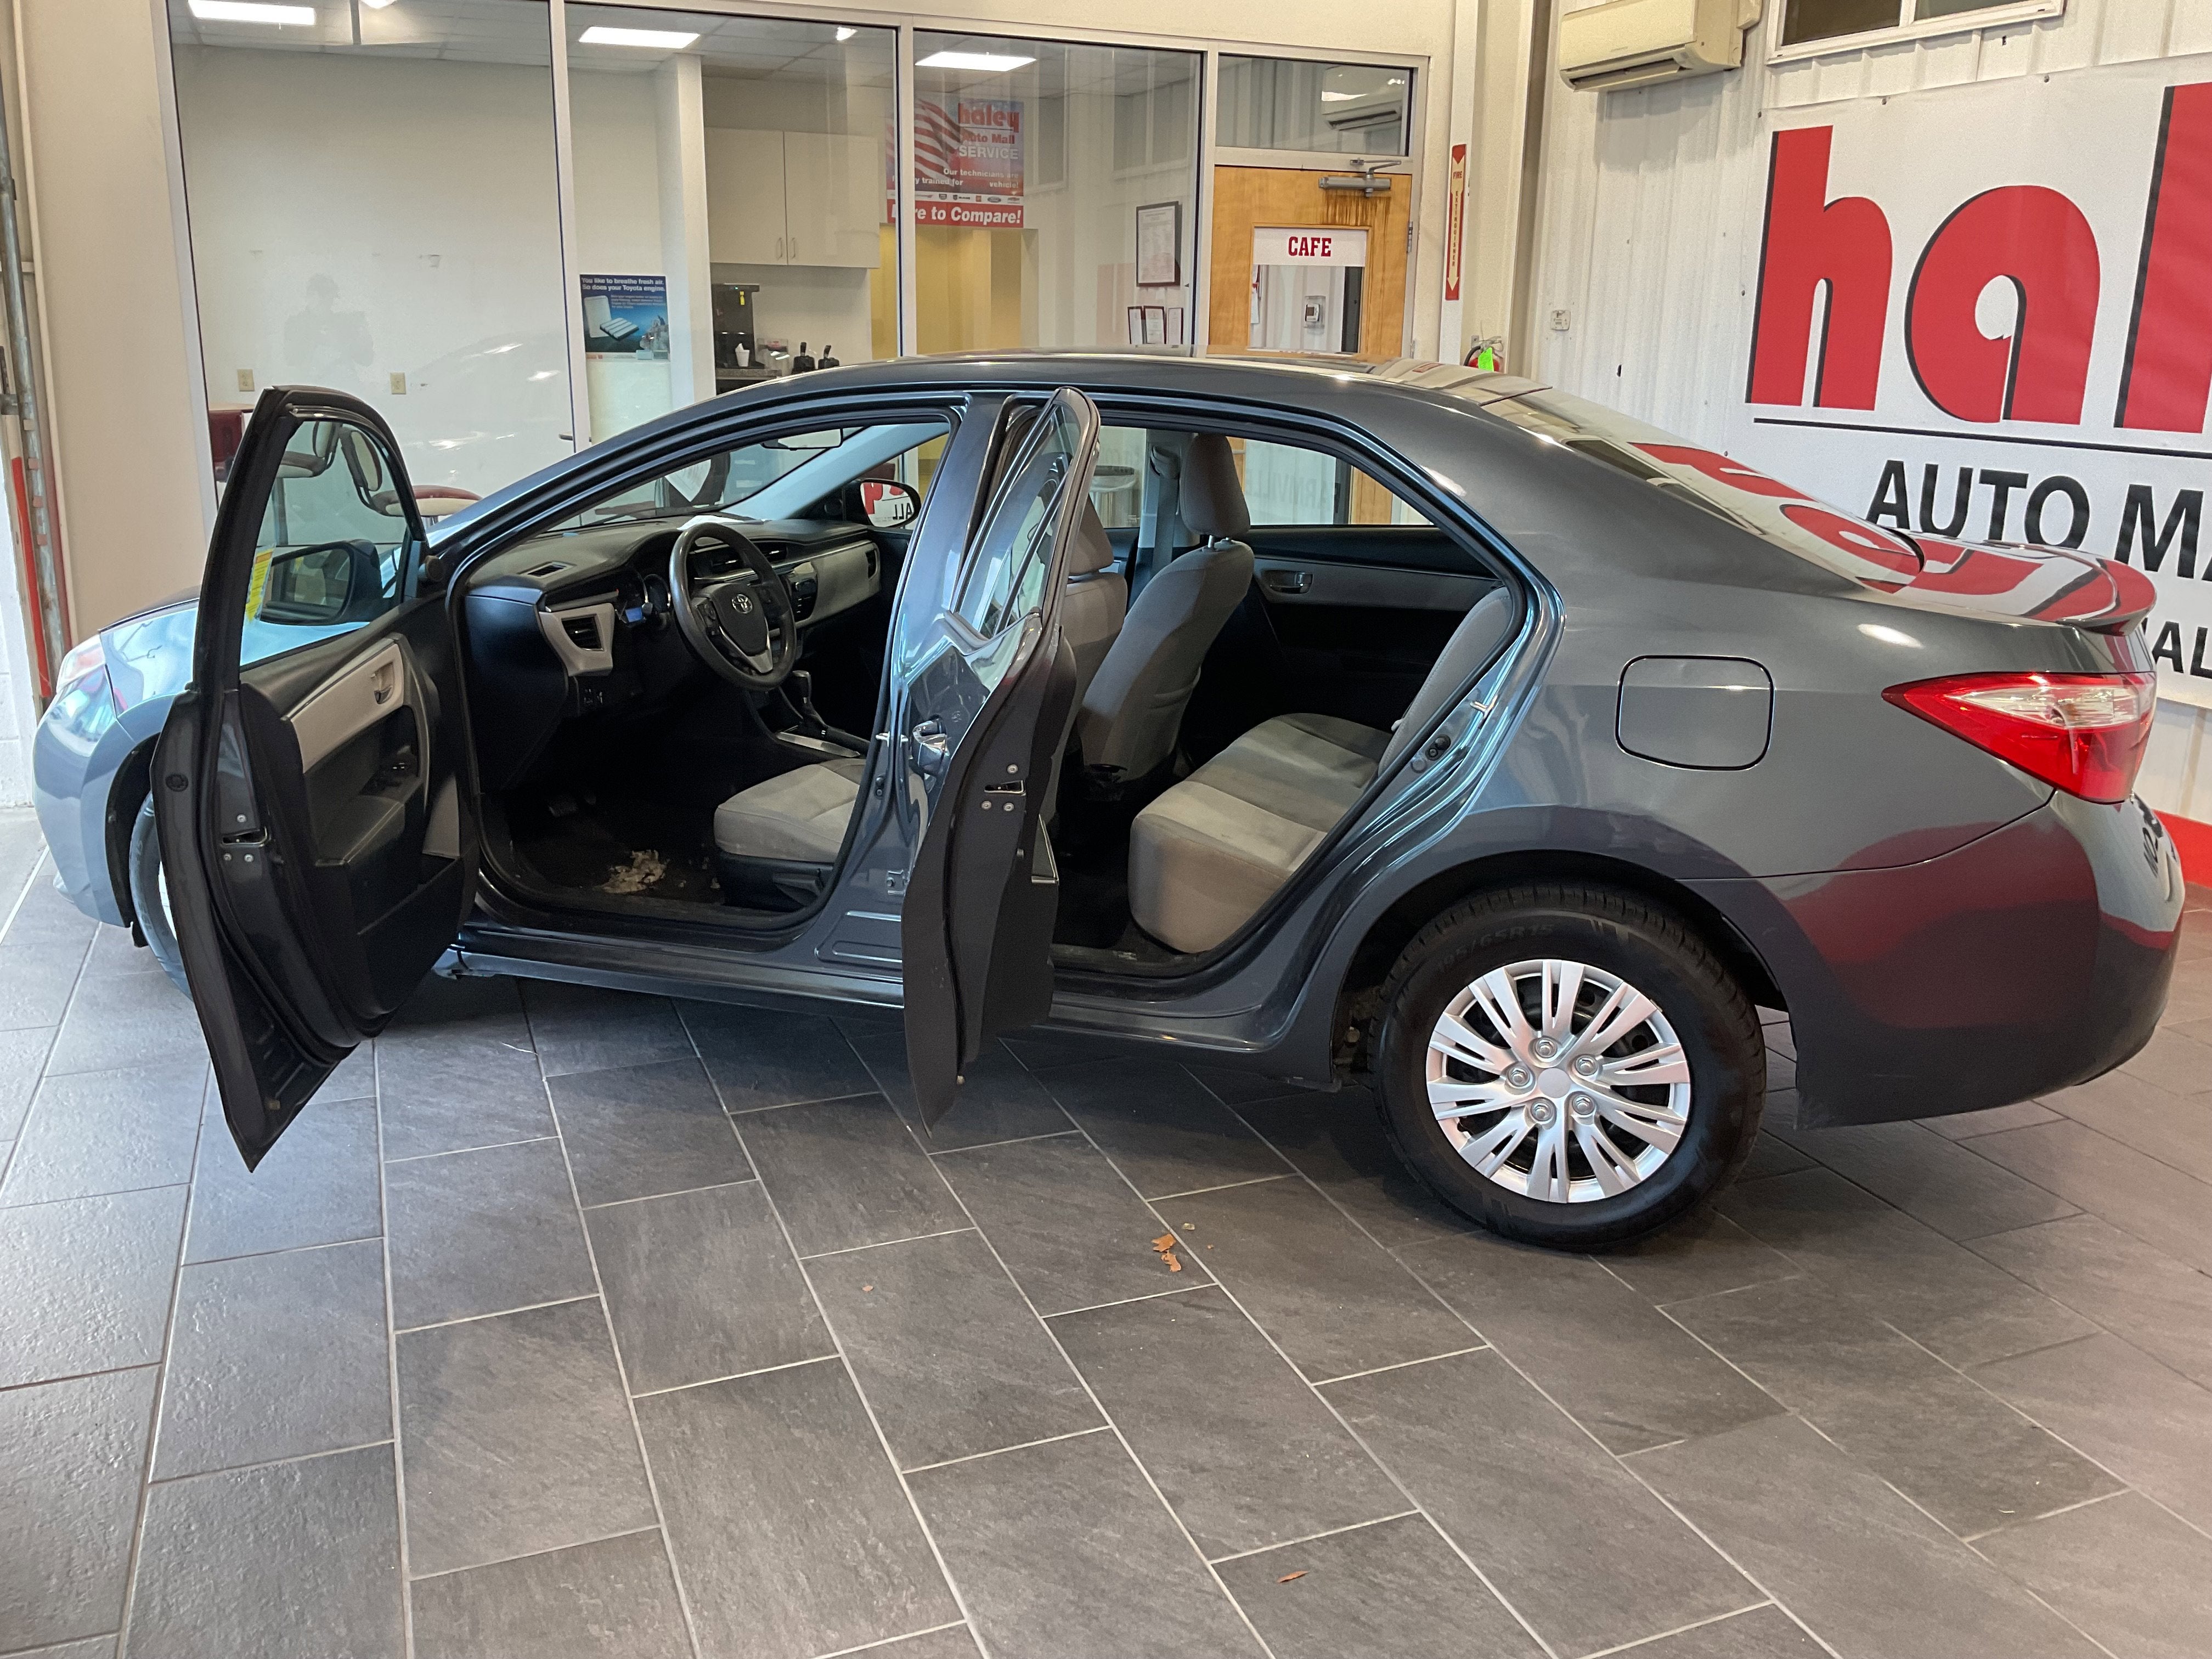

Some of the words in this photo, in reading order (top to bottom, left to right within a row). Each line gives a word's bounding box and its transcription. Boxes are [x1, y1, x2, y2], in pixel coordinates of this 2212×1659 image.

[957, 103, 1020, 133] haley
[991, 133, 1015, 144] Mall
[958, 145, 1019, 160] SERVICE
[960, 169, 1005, 178] technicians
[1453, 171, 1463, 179] FIRE
[952, 178, 963, 187] for
[931, 206, 946, 220] to
[951, 206, 1022, 225] Compare!
[1288, 236, 1332, 257] CAFE
[1867, 460, 2090, 551] AUTO
[2114, 484, 2212, 582] M
[2141, 617, 2212, 679] AL
